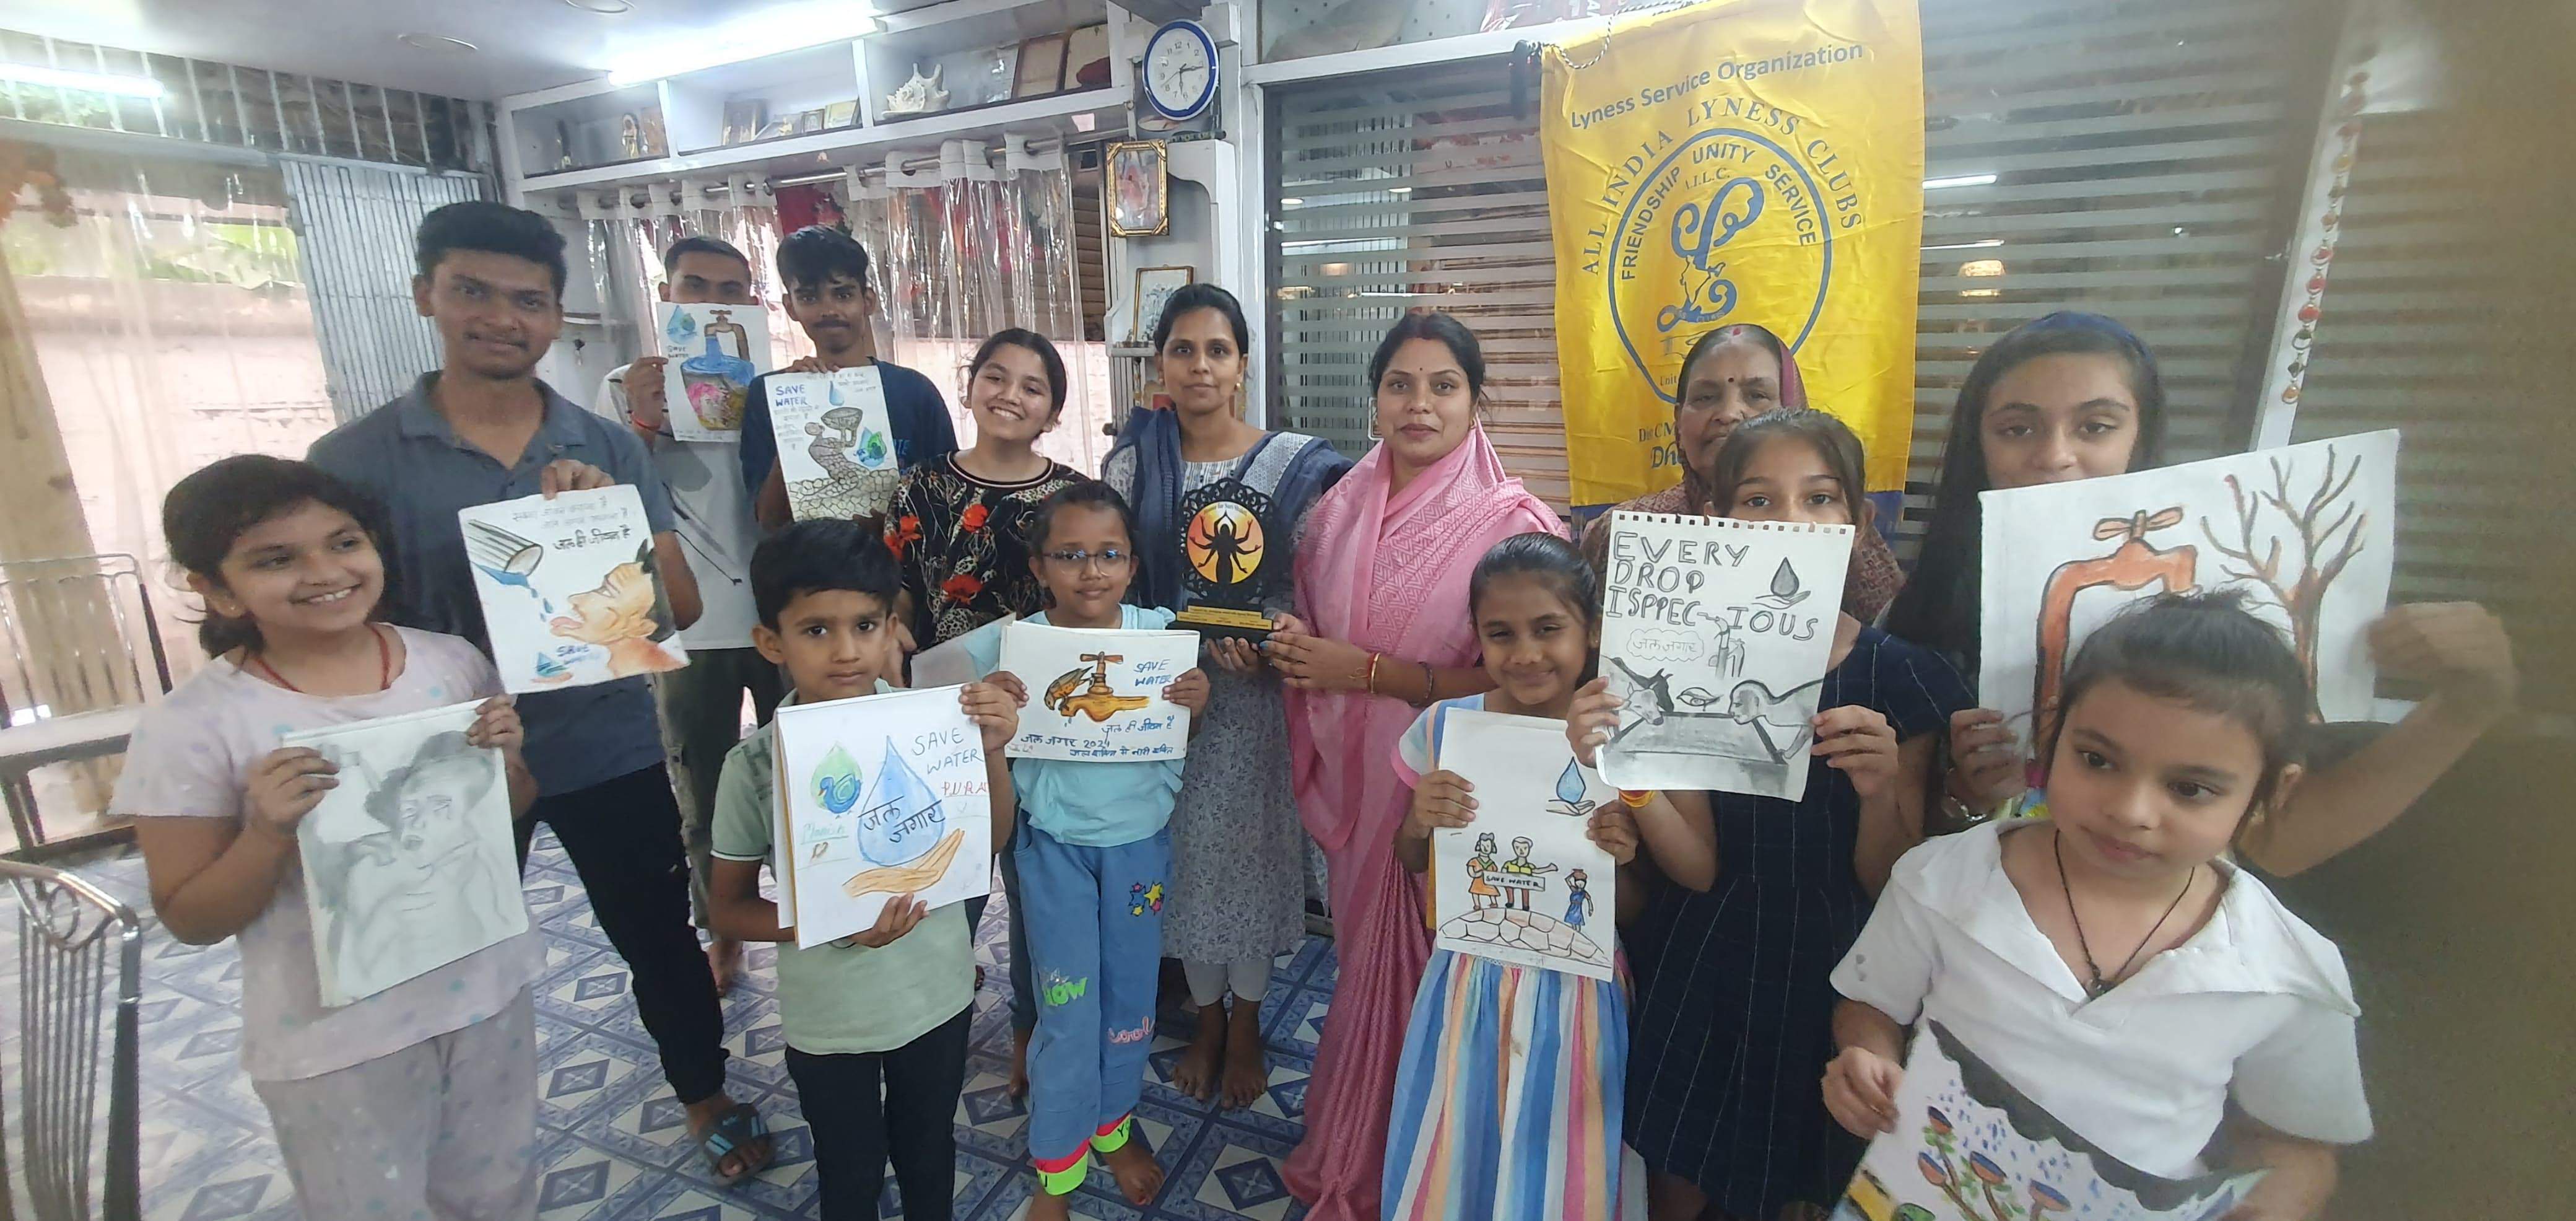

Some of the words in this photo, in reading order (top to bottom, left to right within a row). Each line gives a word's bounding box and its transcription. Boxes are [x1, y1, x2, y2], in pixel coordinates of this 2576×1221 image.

[1572, 95, 1635, 129] Lyness
[1641, 71, 1710, 108] Service
[1718, 43, 1863, 81] Organization
[1582, 224, 1608, 275] ALL
[1601, 130, 1673, 208] INDIA
[1687, 97, 1801, 135] LYNESS
[1807, 139, 1861, 229] CLUBS
[1621, 166, 1680, 280] FRIENDSHIP
[1692, 142, 1756, 164] UNITY
[1765, 164, 1816, 247] SERVICE
[775, 384, 806, 396] SAVE
[775, 396, 811, 407] WATER
[1613, 531, 1750, 567] EVERY
[1614, 559, 1704, 594] DROP
[1134, 659, 1171, 673] SAVE
[1134, 676, 1172, 687] WATER
[912, 727, 964, 756] SAVE
[1020, 733, 1043, 744] जल
[927, 748, 984, 774] WATER
[858, 795, 904, 831] जल
[889, 800, 946, 844] जगार
[1486, 875, 1505, 883] SAVE
[1508, 879, 1544, 889] WATER
